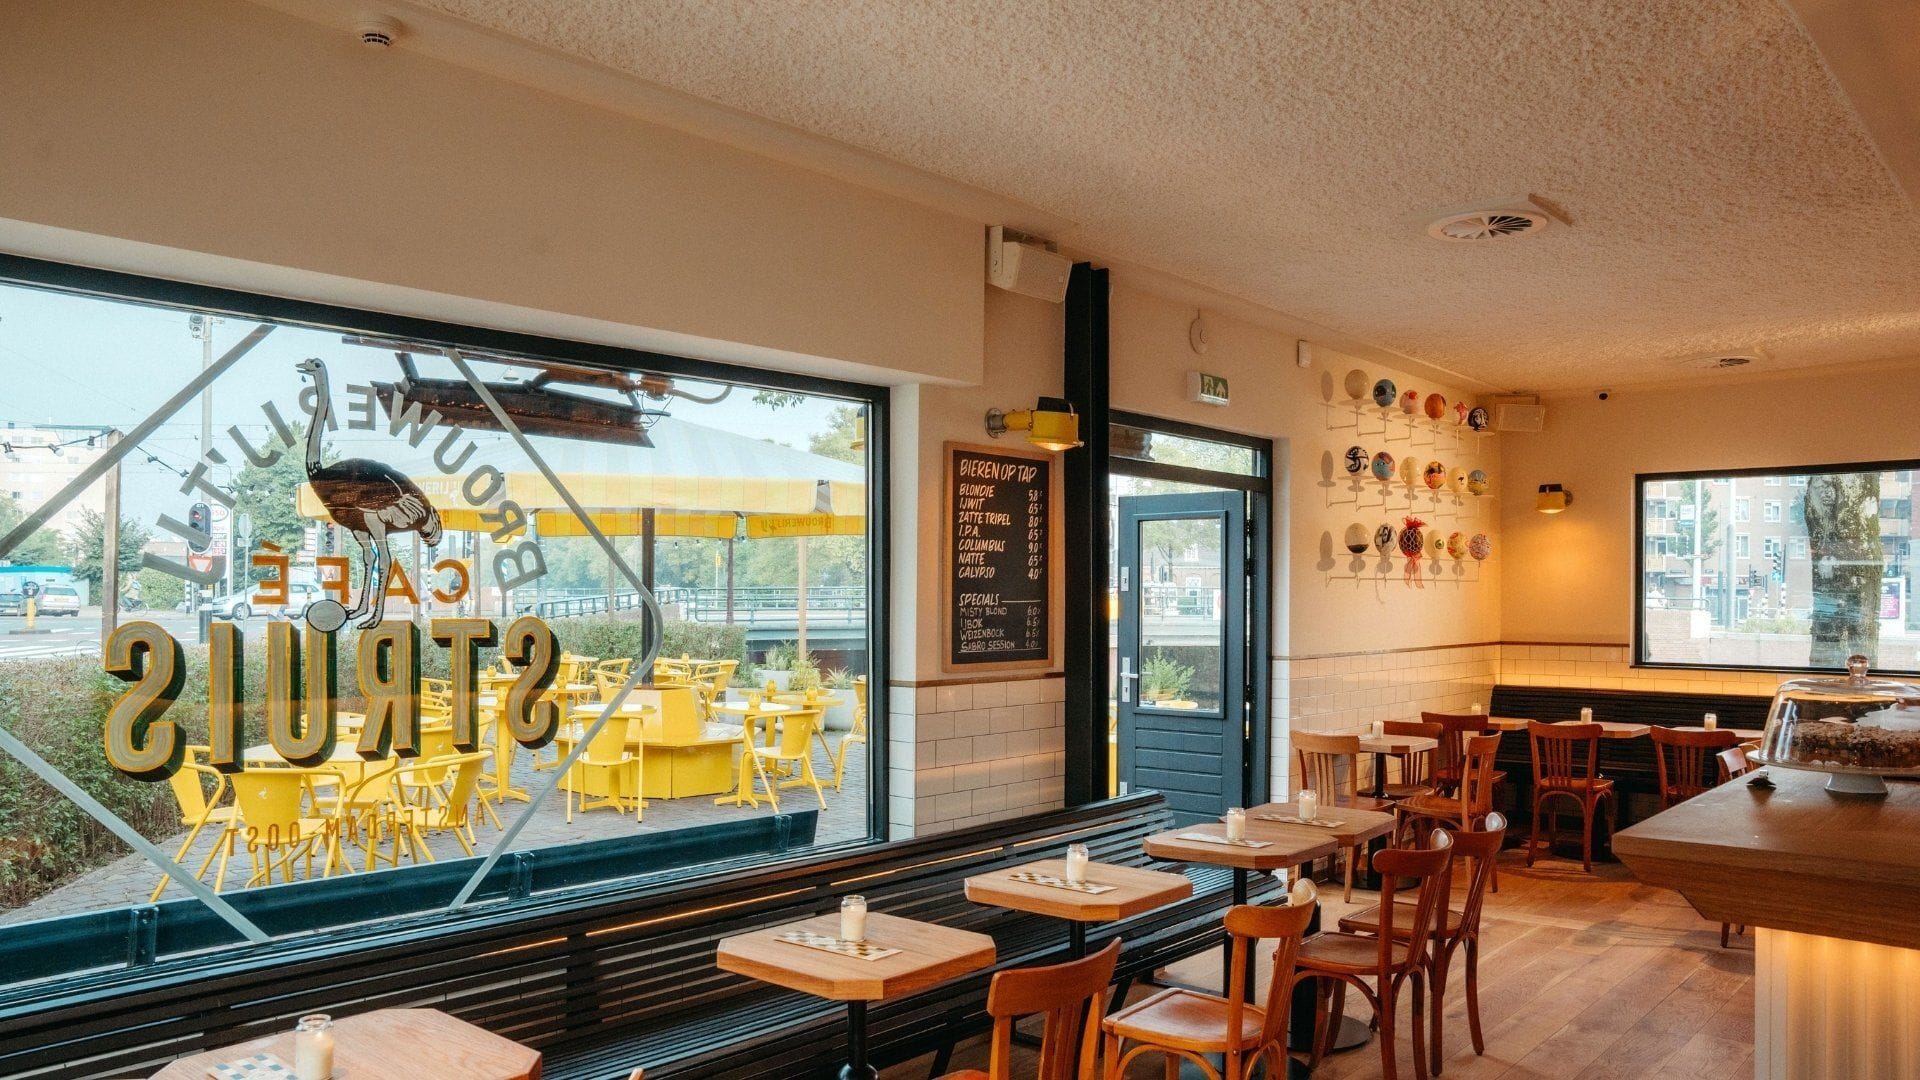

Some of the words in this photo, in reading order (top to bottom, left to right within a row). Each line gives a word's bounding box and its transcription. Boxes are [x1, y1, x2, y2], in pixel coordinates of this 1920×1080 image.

[960, 459, 1000, 479] BIEREN
[1000, 464, 1016, 481] OP
[1018, 465, 1037, 483] TAP
[959, 483, 995, 498] BLONDIE
[960, 498, 985, 510] IJWIT
[959, 511, 984, 524] ZATTE
[985, 512, 1011, 525] TRIPEL
[959, 539, 1005, 552] COLUMBUS
[959, 552, 985, 565] NATTE
[958, 566, 995, 579] CALYPSO
[959, 593, 999, 606] SPECIALS
[960, 607, 982, 617] MISTY
[985, 607, 1007, 616] BLOND
[960, 618, 983, 630] IJBOK
[960, 628, 1004, 641] WEIZENBOCK
[988, 640, 1015, 650] SESSION
